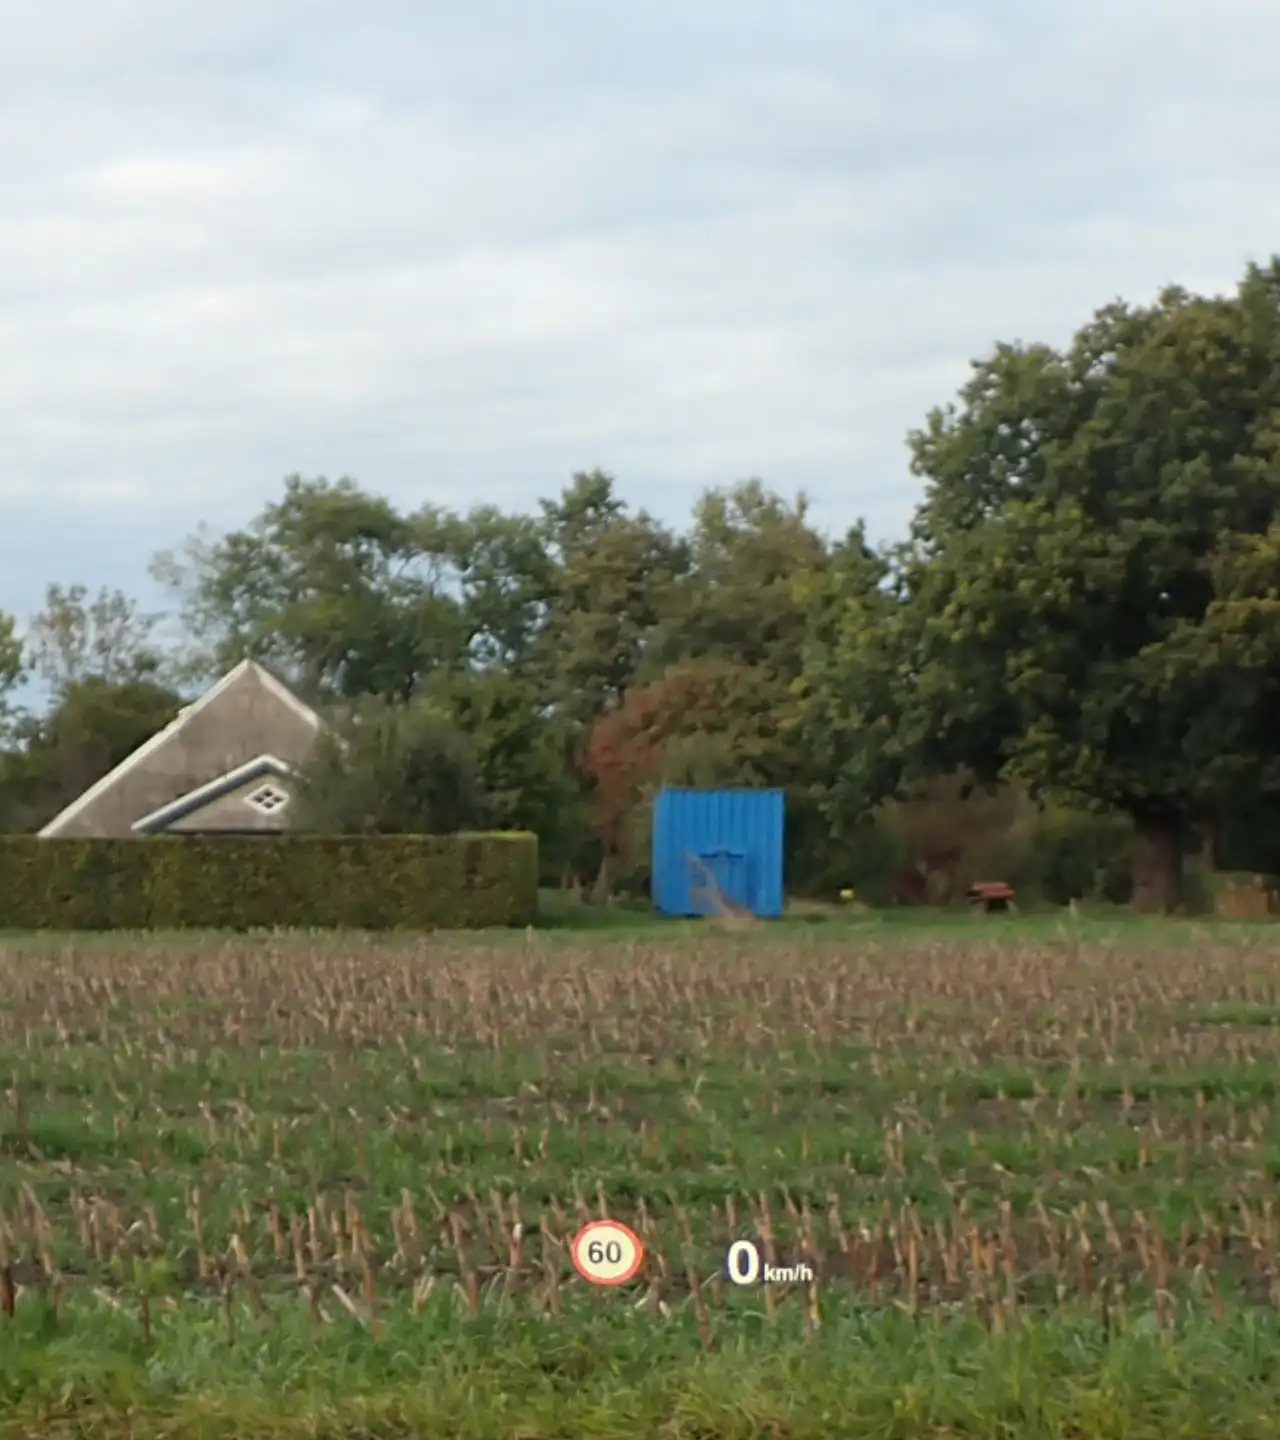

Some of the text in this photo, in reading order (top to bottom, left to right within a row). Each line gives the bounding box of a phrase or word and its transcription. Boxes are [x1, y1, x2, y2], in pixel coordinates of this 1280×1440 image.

[588, 1240, 622, 1264] 60
[727, 1240, 813, 1285] 0 km/h
